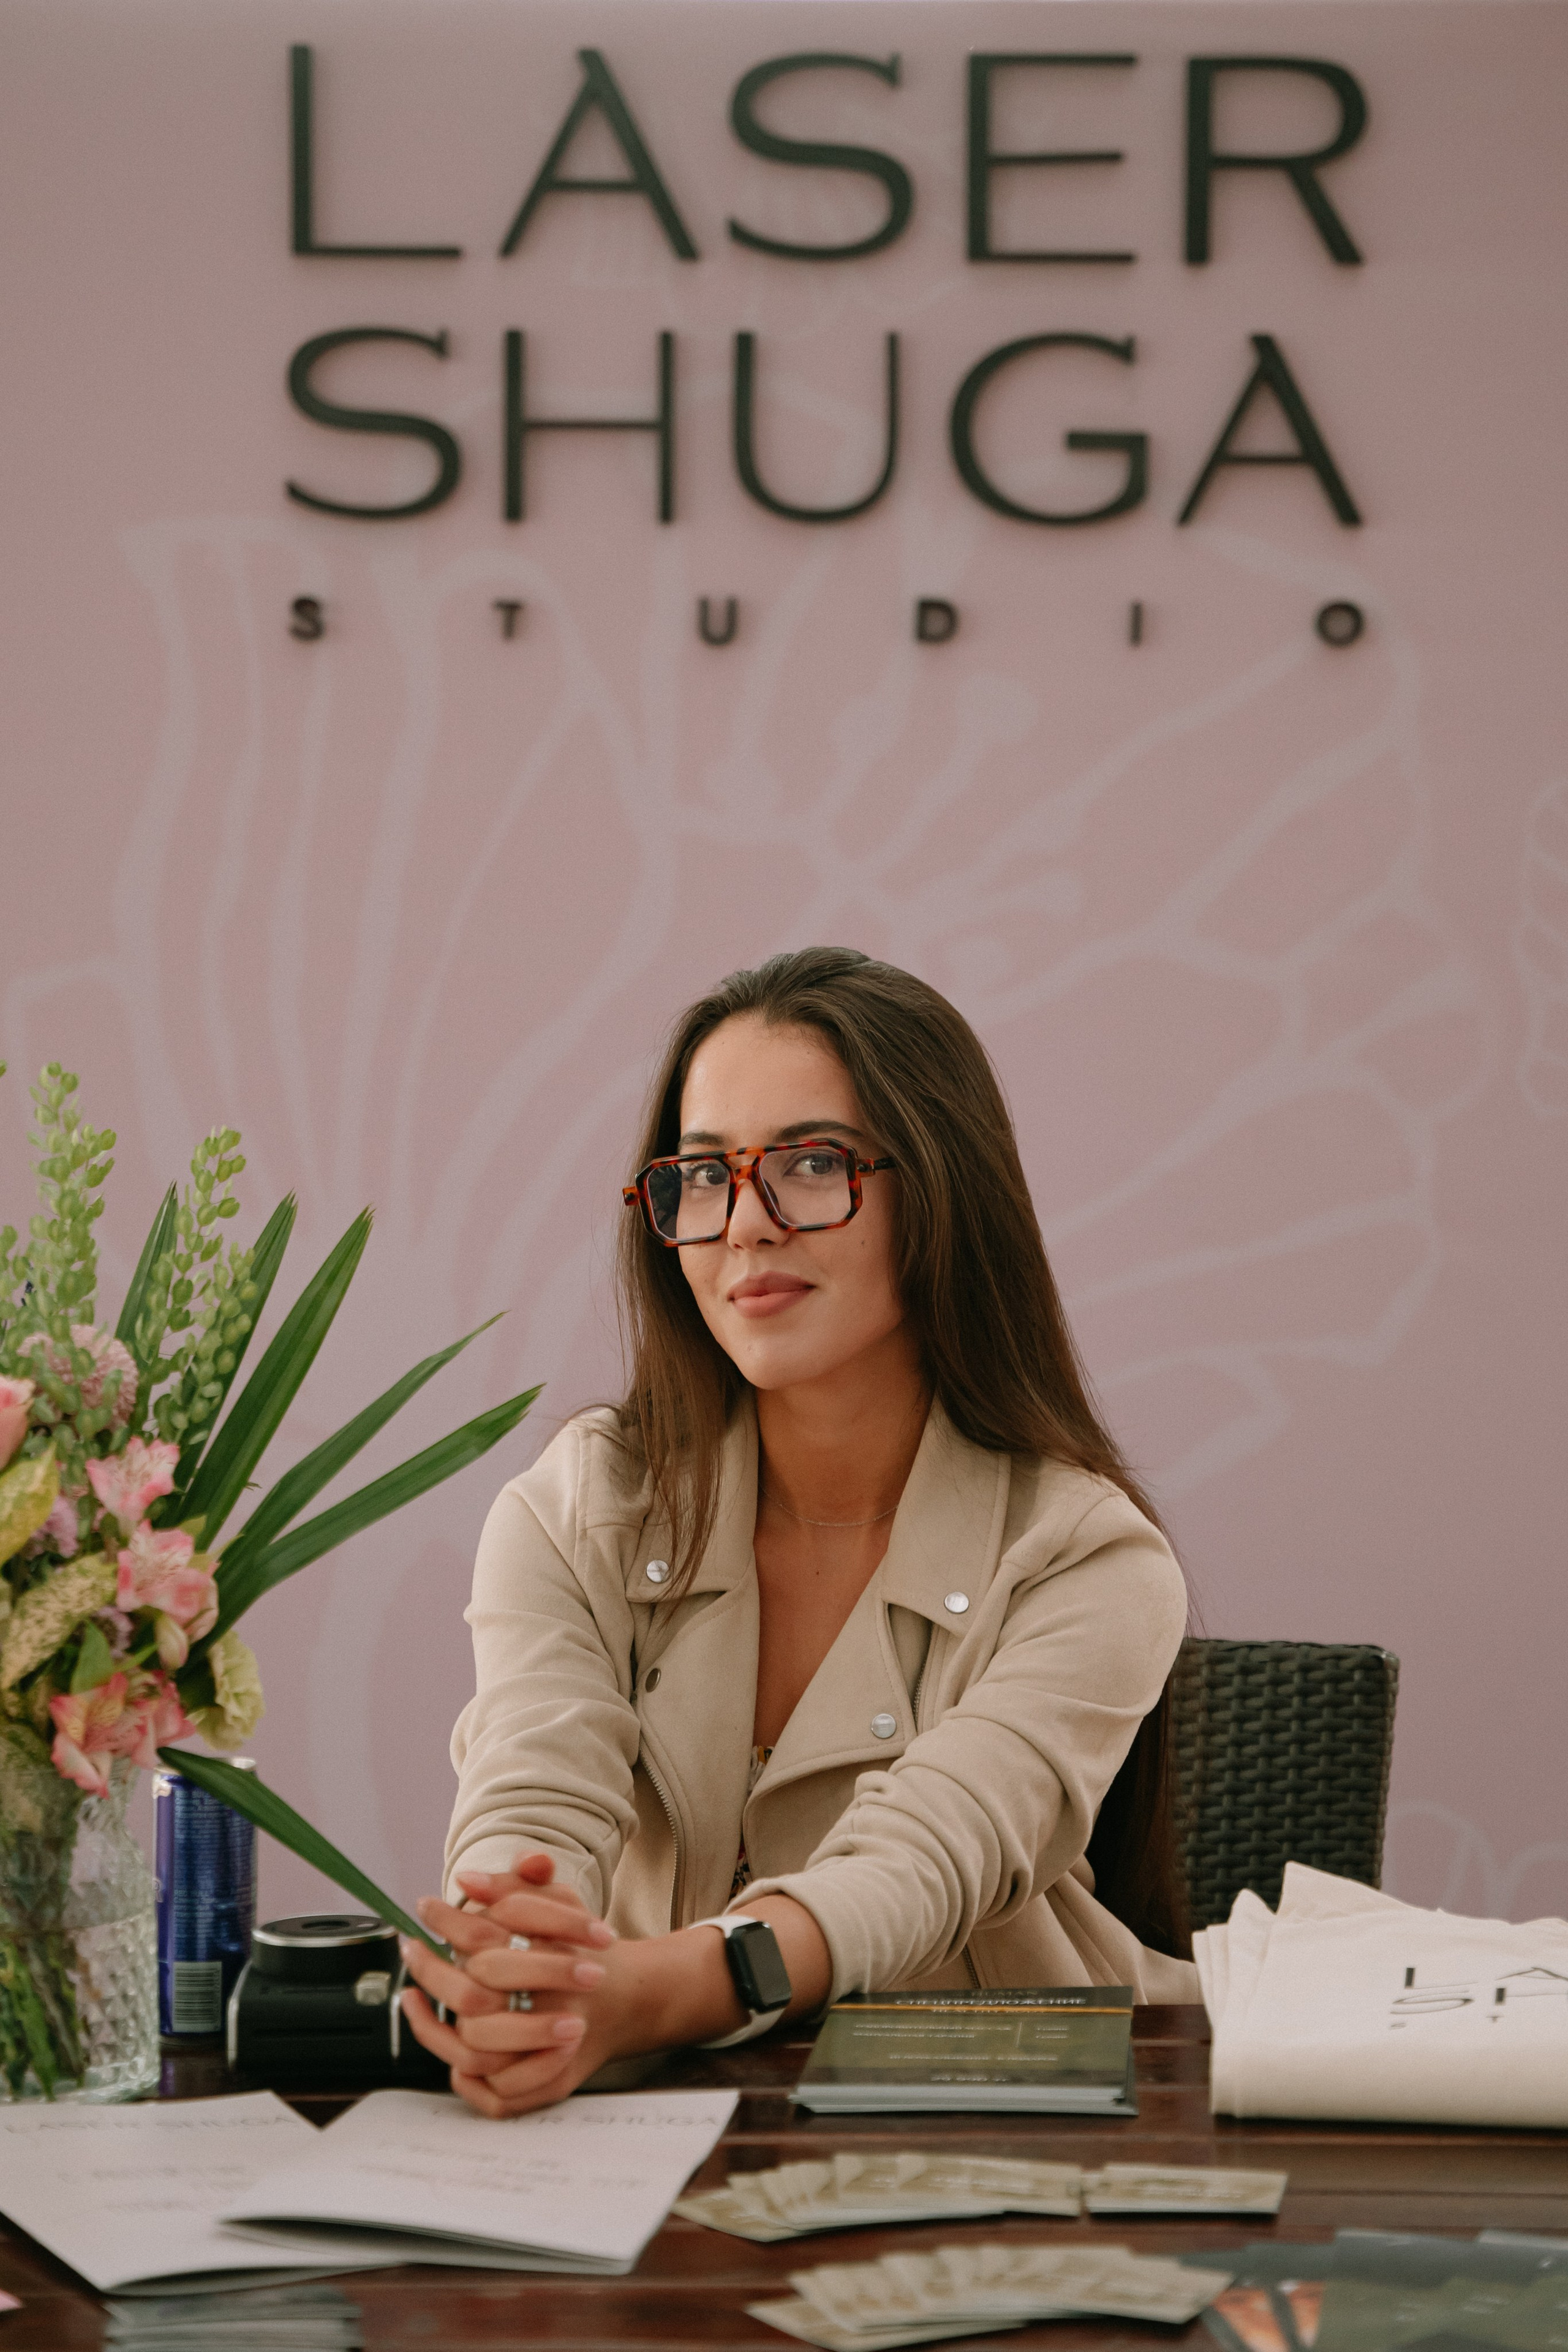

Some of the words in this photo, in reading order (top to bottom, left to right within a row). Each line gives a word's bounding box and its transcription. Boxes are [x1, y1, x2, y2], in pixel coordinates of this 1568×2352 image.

[290, 46, 1371, 270] LASER
[286, 326, 1363, 529] SHUGA
[290, 596, 1366, 649] STUDIO
